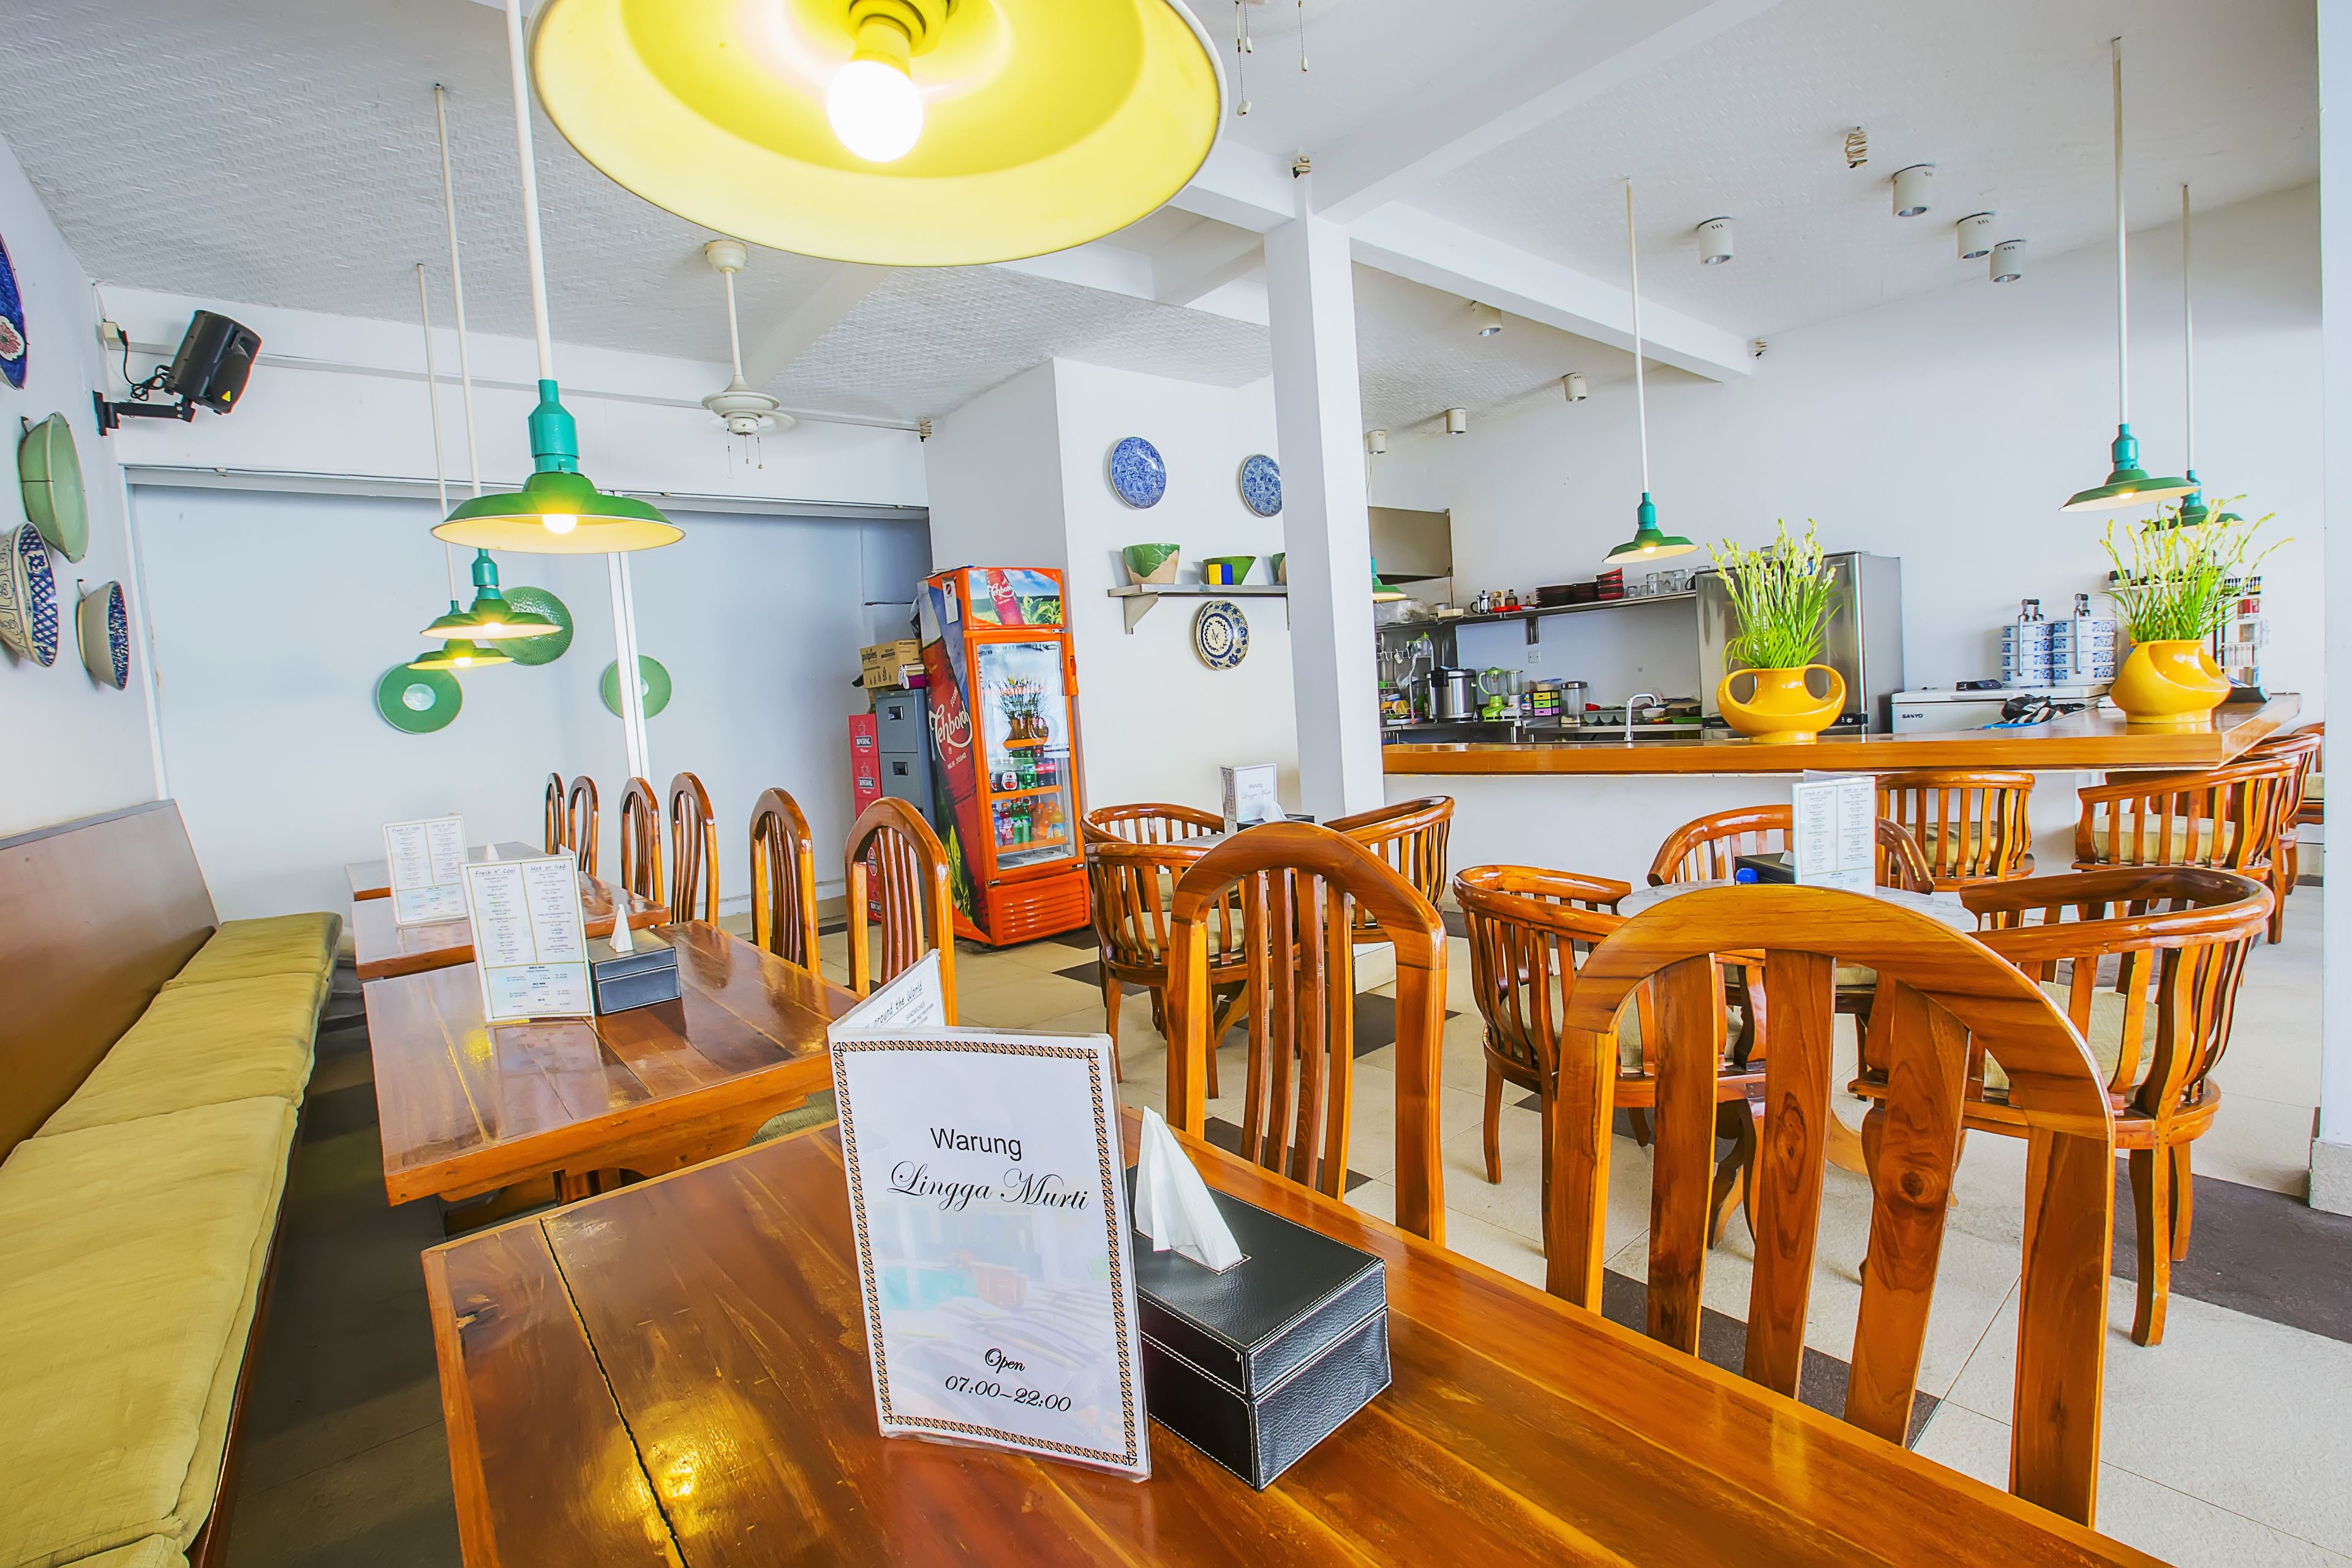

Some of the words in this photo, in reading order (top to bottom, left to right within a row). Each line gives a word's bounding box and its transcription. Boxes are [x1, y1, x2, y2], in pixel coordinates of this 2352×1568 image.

[874, 1003, 893, 1026] around
[895, 995, 905, 1010] the
[907, 979, 922, 1001] World
[906, 1001, 925, 1021] SANDWICHES
[930, 1127, 1022, 1161] Warung
[886, 1161, 993, 1212] Lingga
[1000, 1168, 1089, 1210] Murti
[985, 1348, 1025, 1374] Open
